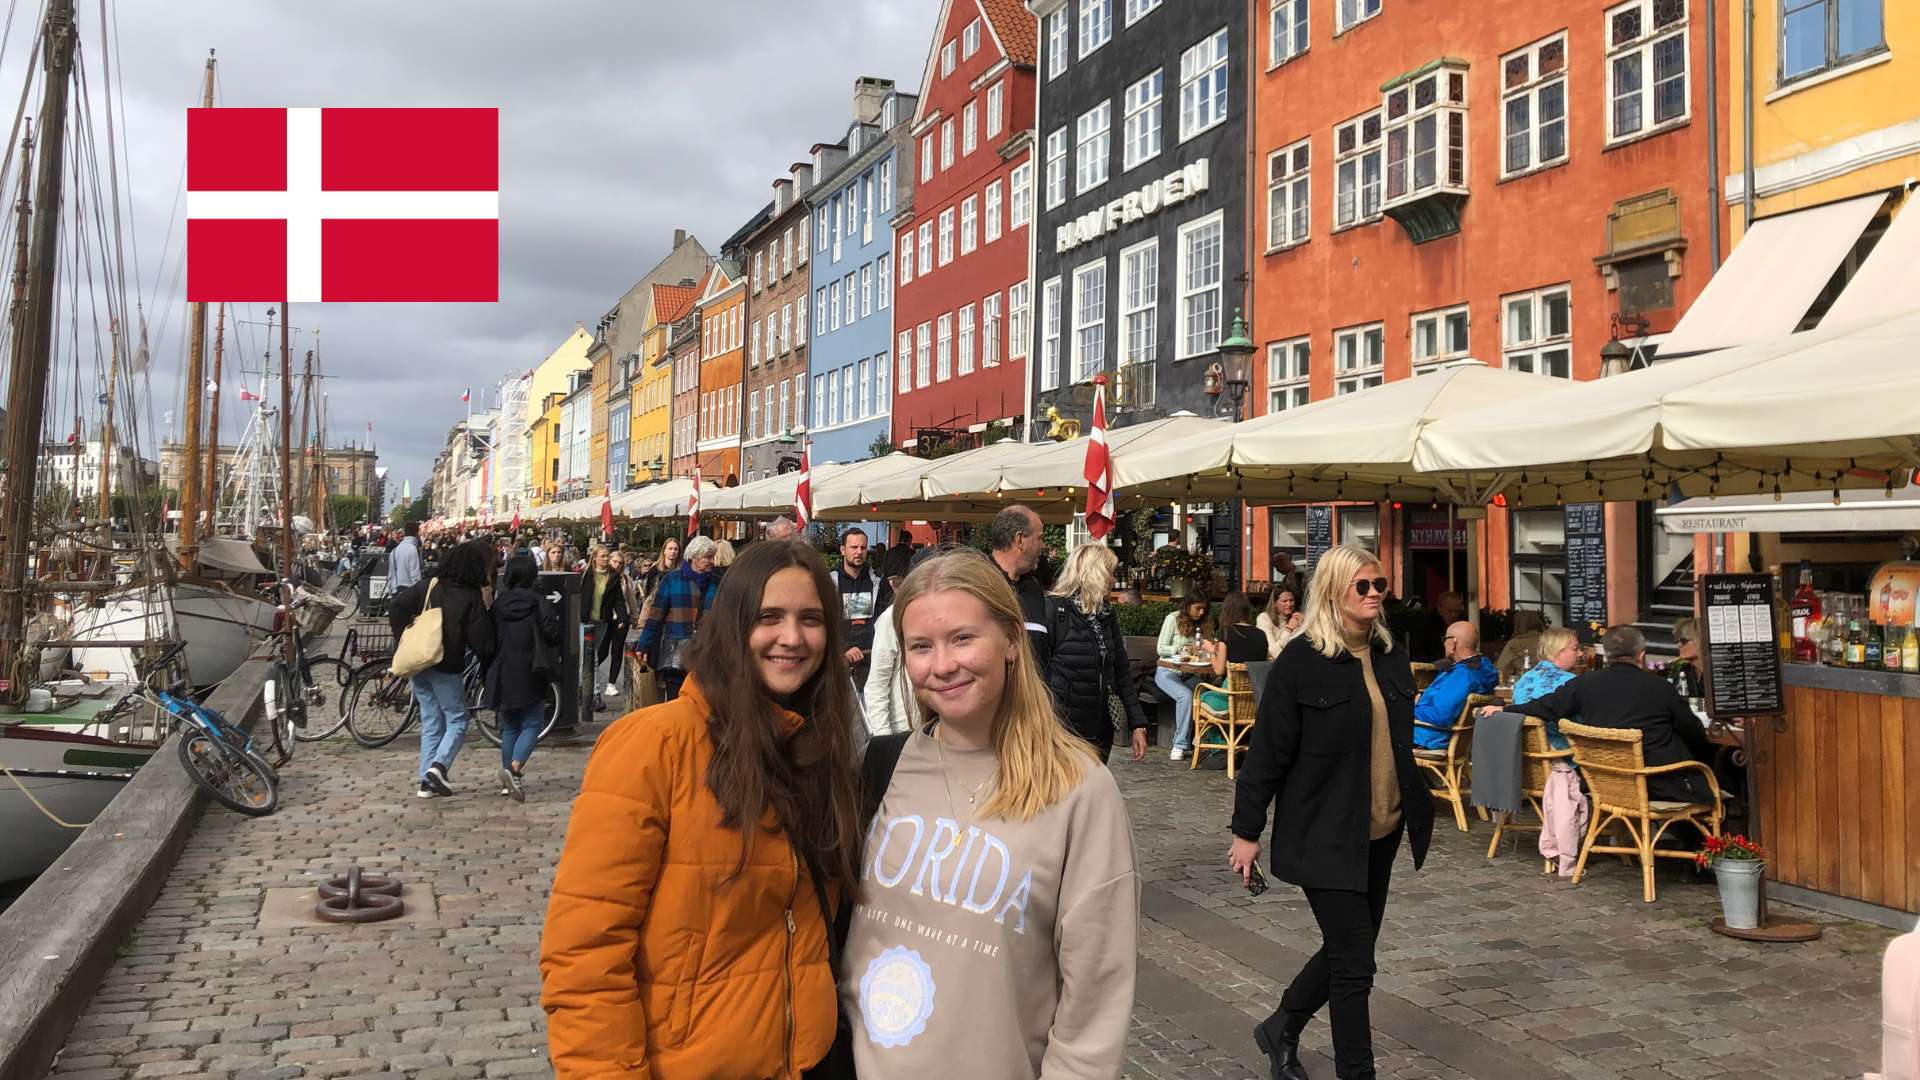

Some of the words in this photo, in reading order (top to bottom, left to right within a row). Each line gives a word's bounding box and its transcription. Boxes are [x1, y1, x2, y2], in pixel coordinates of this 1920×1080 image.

[1056, 157, 1209, 253] HAVFRUEN
[920, 435, 941, 456] 37
[1682, 517, 1745, 529] RESTAURANT
[867, 909, 888, 923] LIFE
[894, 916, 913, 932] ONE
[918, 923, 942, 942] WAVE
